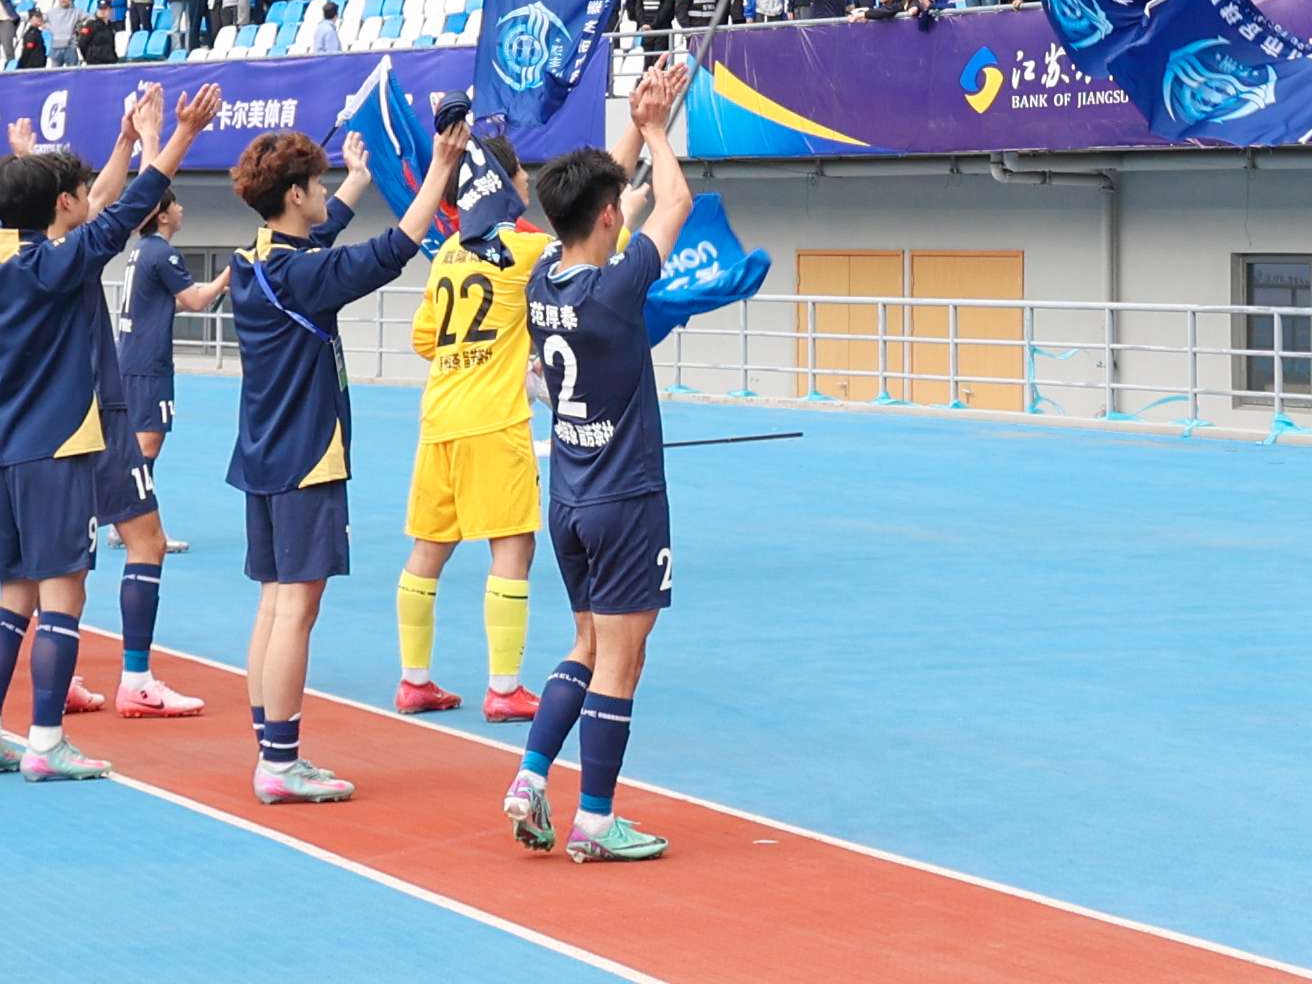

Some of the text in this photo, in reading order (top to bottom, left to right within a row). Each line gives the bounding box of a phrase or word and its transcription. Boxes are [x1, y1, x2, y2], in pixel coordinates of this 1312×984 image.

[216, 99, 298, 130] 卡尔美体育
[1012, 89, 1129, 108] BANK OF JIANGSU
[435, 272, 499, 347] 22
[543, 334, 588, 419] 2
[656, 547, 673, 591] 2
